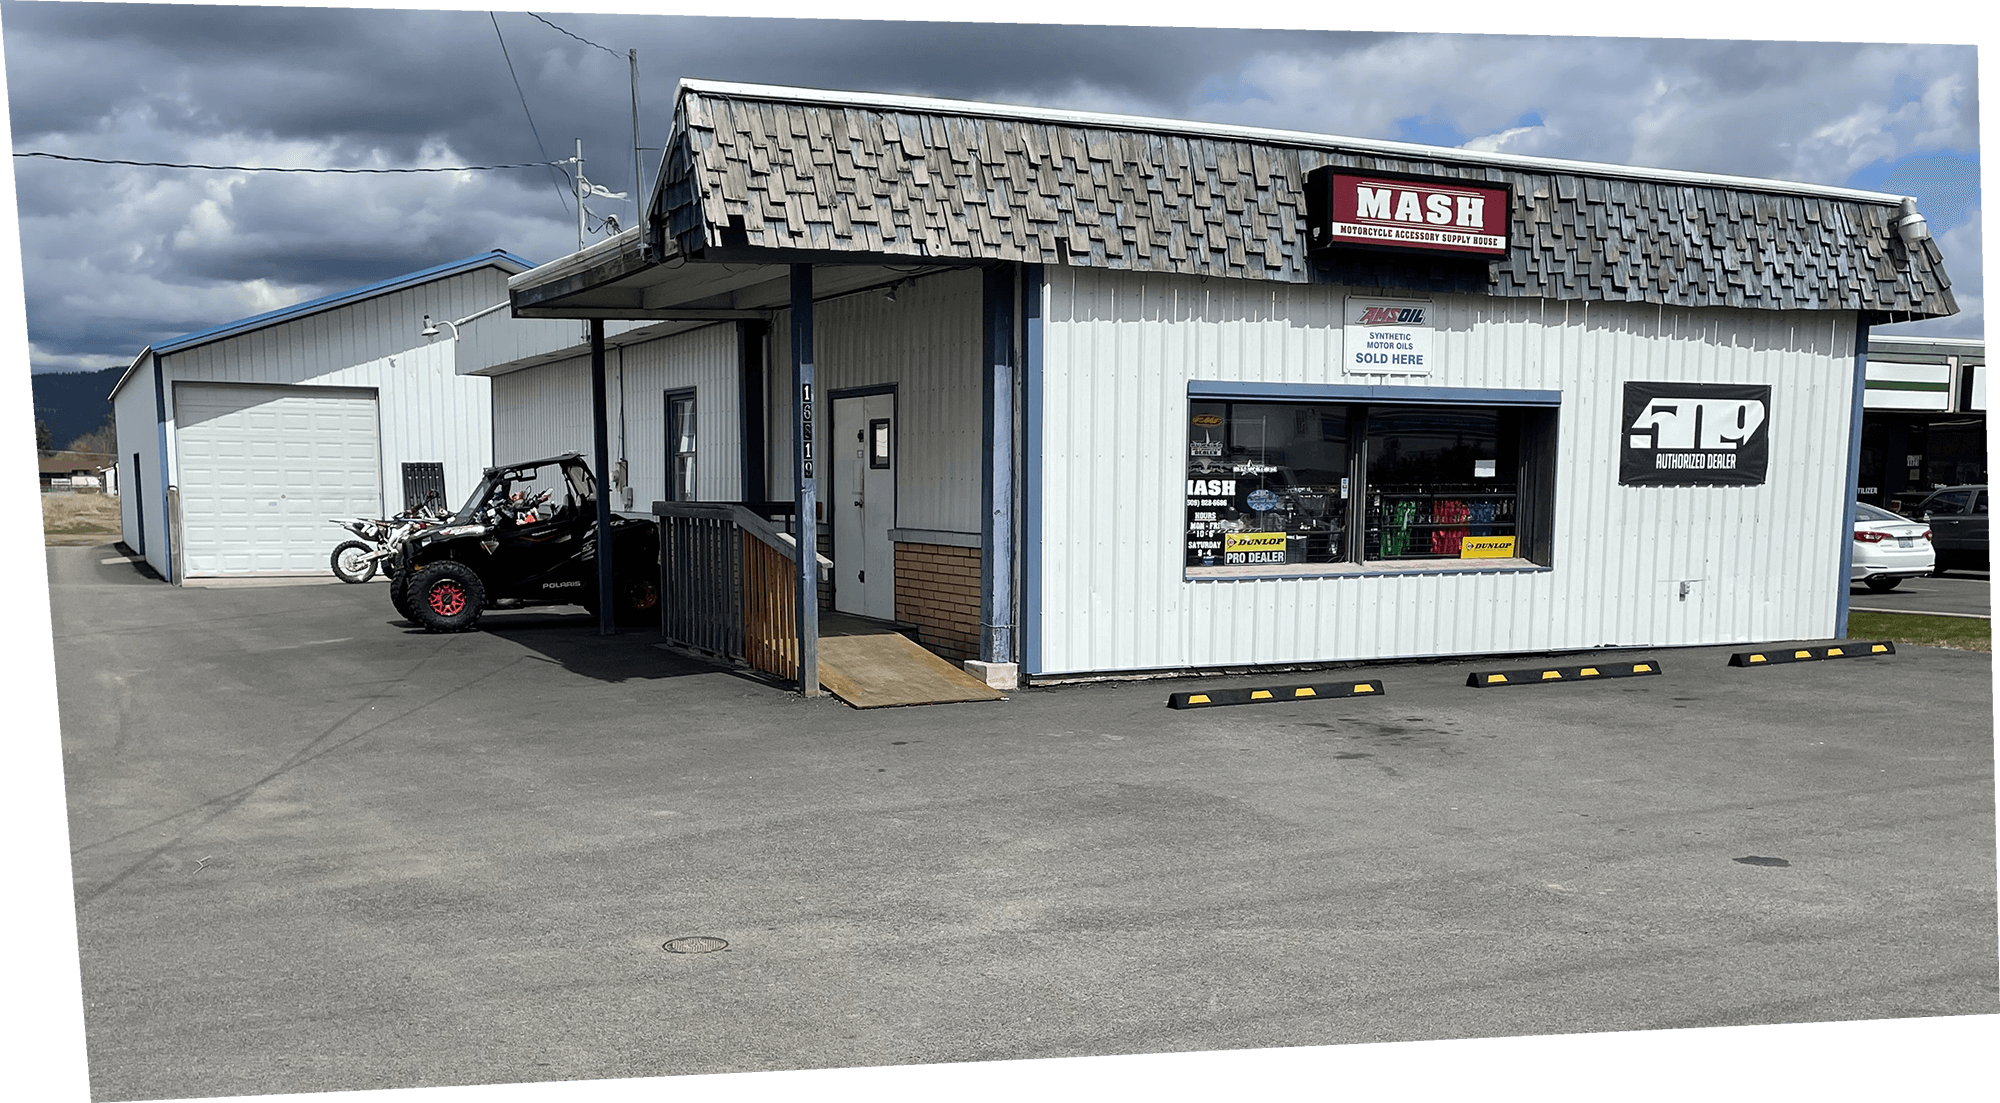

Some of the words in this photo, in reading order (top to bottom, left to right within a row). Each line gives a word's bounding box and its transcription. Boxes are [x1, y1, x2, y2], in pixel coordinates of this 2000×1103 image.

[1356, 186, 1485, 228] MASH
[1340, 225, 1393, 238] MOTORCYCLE
[1395, 229, 1440, 242] ACCESSORY
[1442, 234, 1471, 245] SUPPLY
[1473, 236, 1498, 246] HOUSE
[1355, 307, 1426, 326] AMSOIL
[1369, 332, 1411, 340] SYNTHETIC
[1367, 341, 1394, 350] MOTOR
[1396, 342, 1414, 350] OILS
[1356, 352, 1388, 364] SOLD
[1392, 354, 1424, 365] HERE
[1655, 453, 1706, 469] AUTHORIZED
[1706, 453, 1737, 469] DEALER
[1190, 522, 1205, 530] MON
[1209, 522, 1221, 530] FRI
[1196, 530, 1204, 538] 10
[1188, 541, 1222, 549] SATURDAY
[1238, 538, 1284, 546] DUNLOP
[1226, 552, 1246, 564] PRO
[1248, 552, 1284, 563] DEALER
[542, 580, 581, 589] POLARIS
